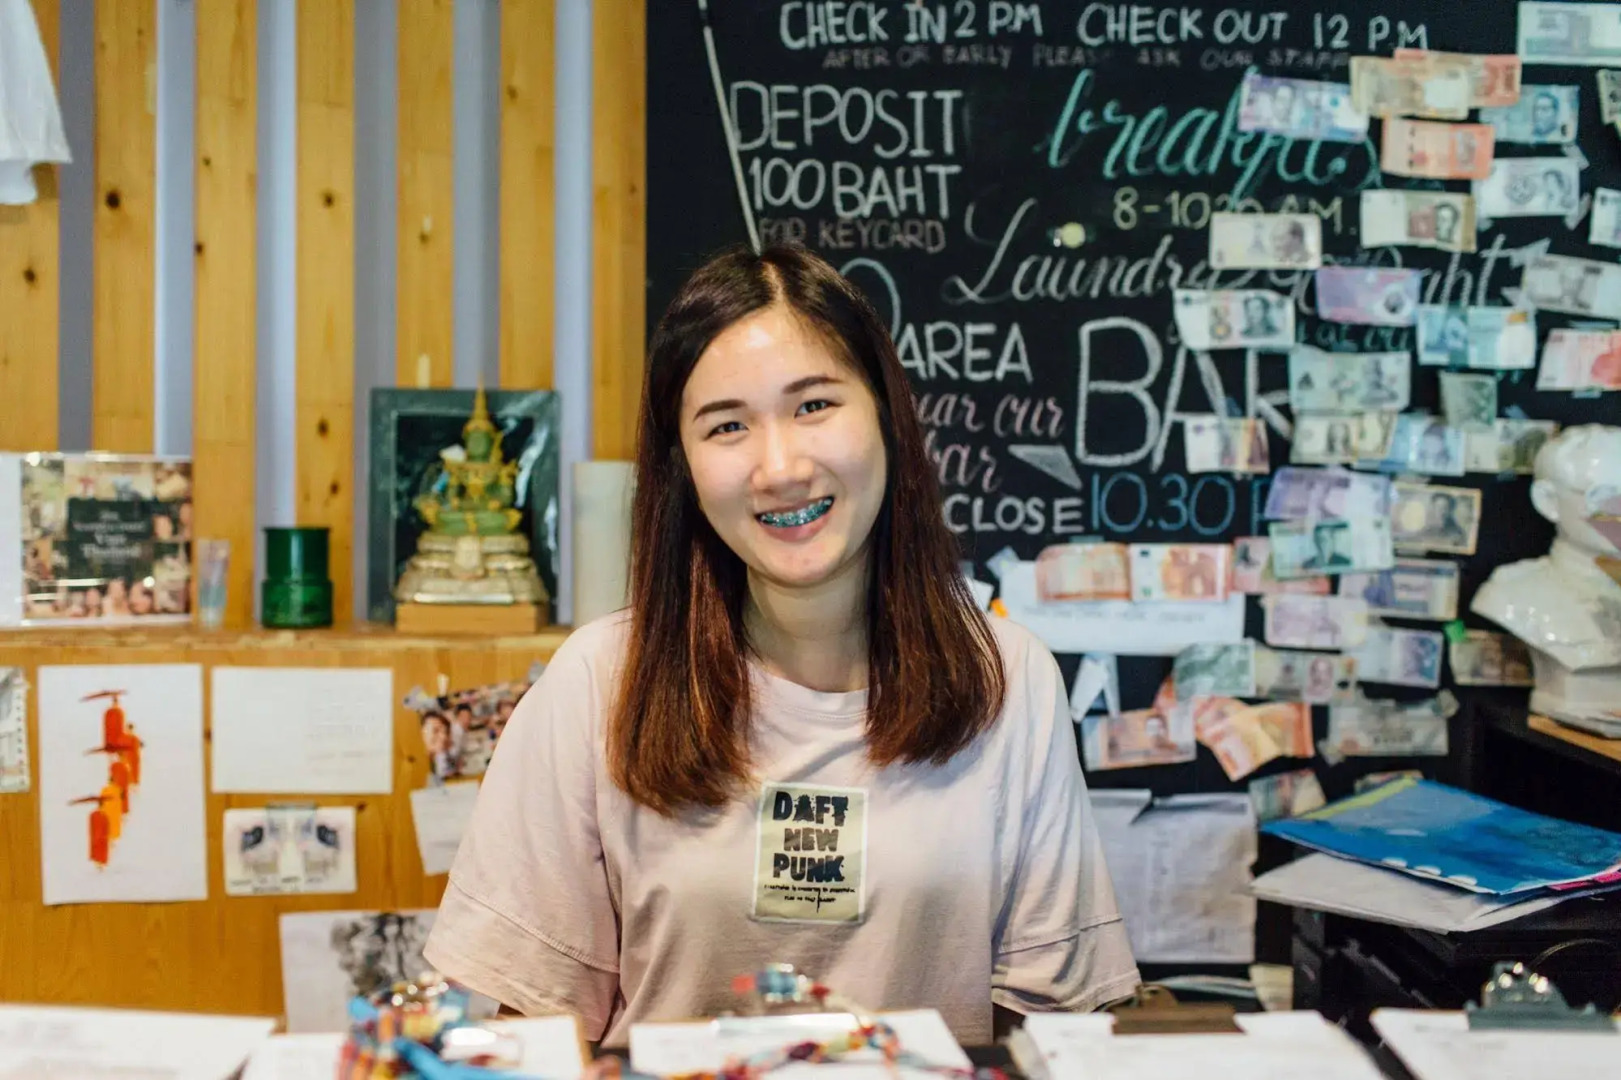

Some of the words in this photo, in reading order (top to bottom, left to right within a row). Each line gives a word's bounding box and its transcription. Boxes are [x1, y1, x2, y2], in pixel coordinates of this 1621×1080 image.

[779, 2, 889, 50] CHECK
[903, 4, 946, 44] IN
[953, 2, 977, 38] 2
[1077, 3, 1202, 47] CHECK
[1213, 11, 1290, 44] OUT
[1312, 13, 1350, 50] 12
[942, 44, 1012, 70] EARLY
[730, 81, 963, 158] DEPOSIT
[748, 157, 827, 211] 100
[832, 161, 962, 219] BAHT
[818, 218, 946, 253] KEYCARD
[898, 321, 1034, 383] AREA
[942, 492, 1086, 535] CLOSE
[1090, 471, 1236, 537] 10.30
[772, 790, 849, 827] DAFT
[783, 827, 839, 851] NEW
[772, 852, 845, 882] PUNK
